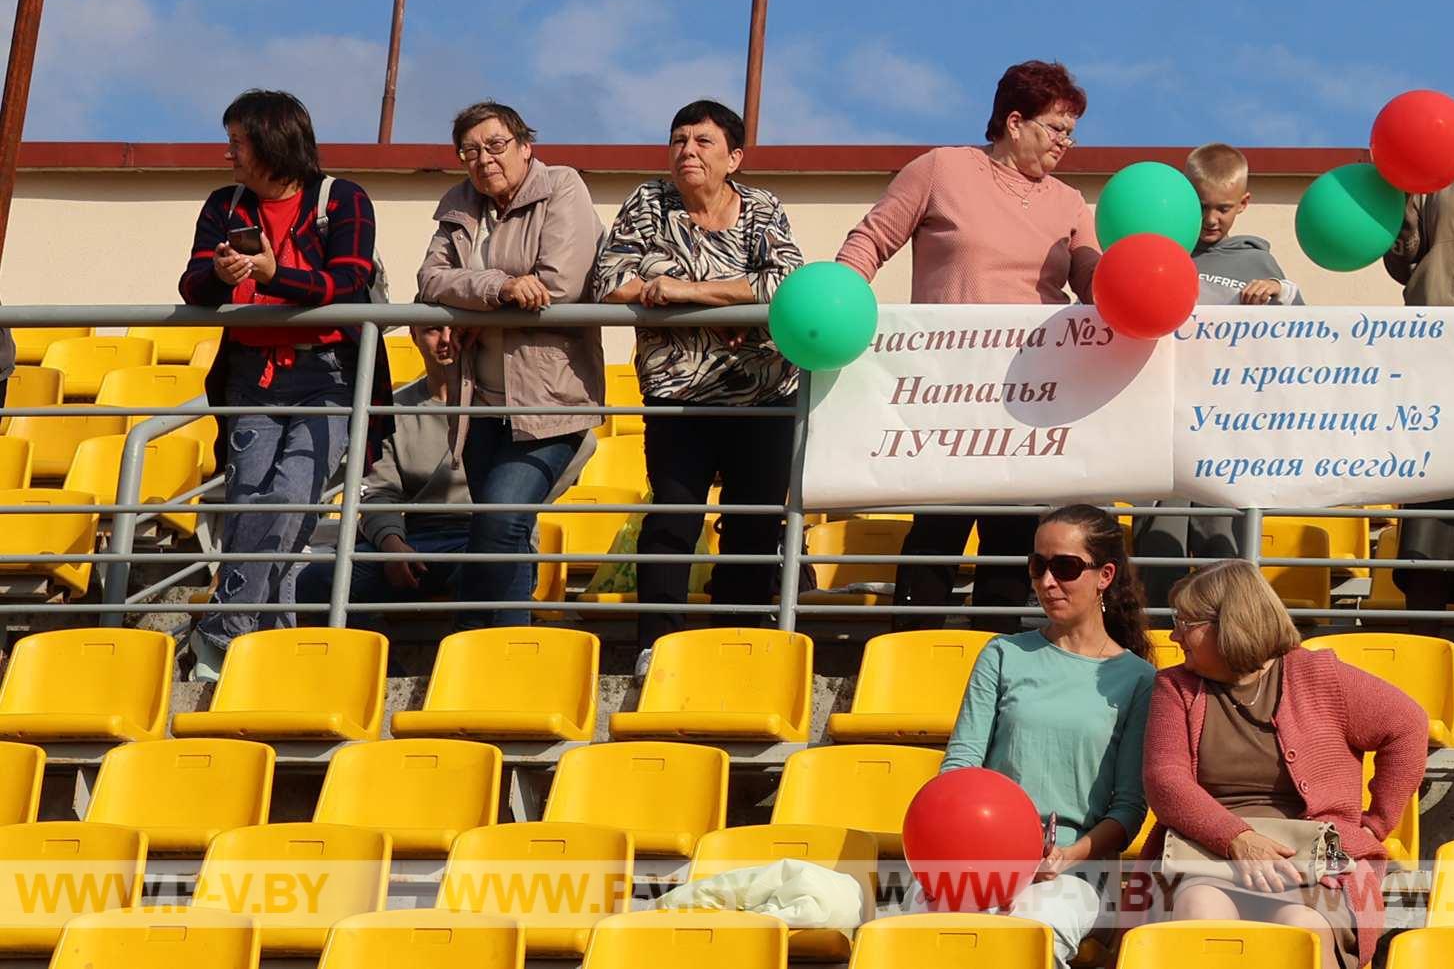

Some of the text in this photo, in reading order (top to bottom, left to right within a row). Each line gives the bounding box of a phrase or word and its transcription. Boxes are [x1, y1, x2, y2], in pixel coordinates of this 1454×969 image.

[1199, 273, 1247, 290] EVERES
[870, 324, 1047, 355] частница
[1351, 313, 1444, 346] драйв
[888, 375, 1057, 405] Наталья
[1208, 368, 1230, 385] и
[1240, 366, 1379, 392] красота
[1190, 405, 1440, 436] Участница №3
[870, 426, 1072, 459] ЛУЧШАЯ
[1192, 451, 1431, 486] первая всегда!
